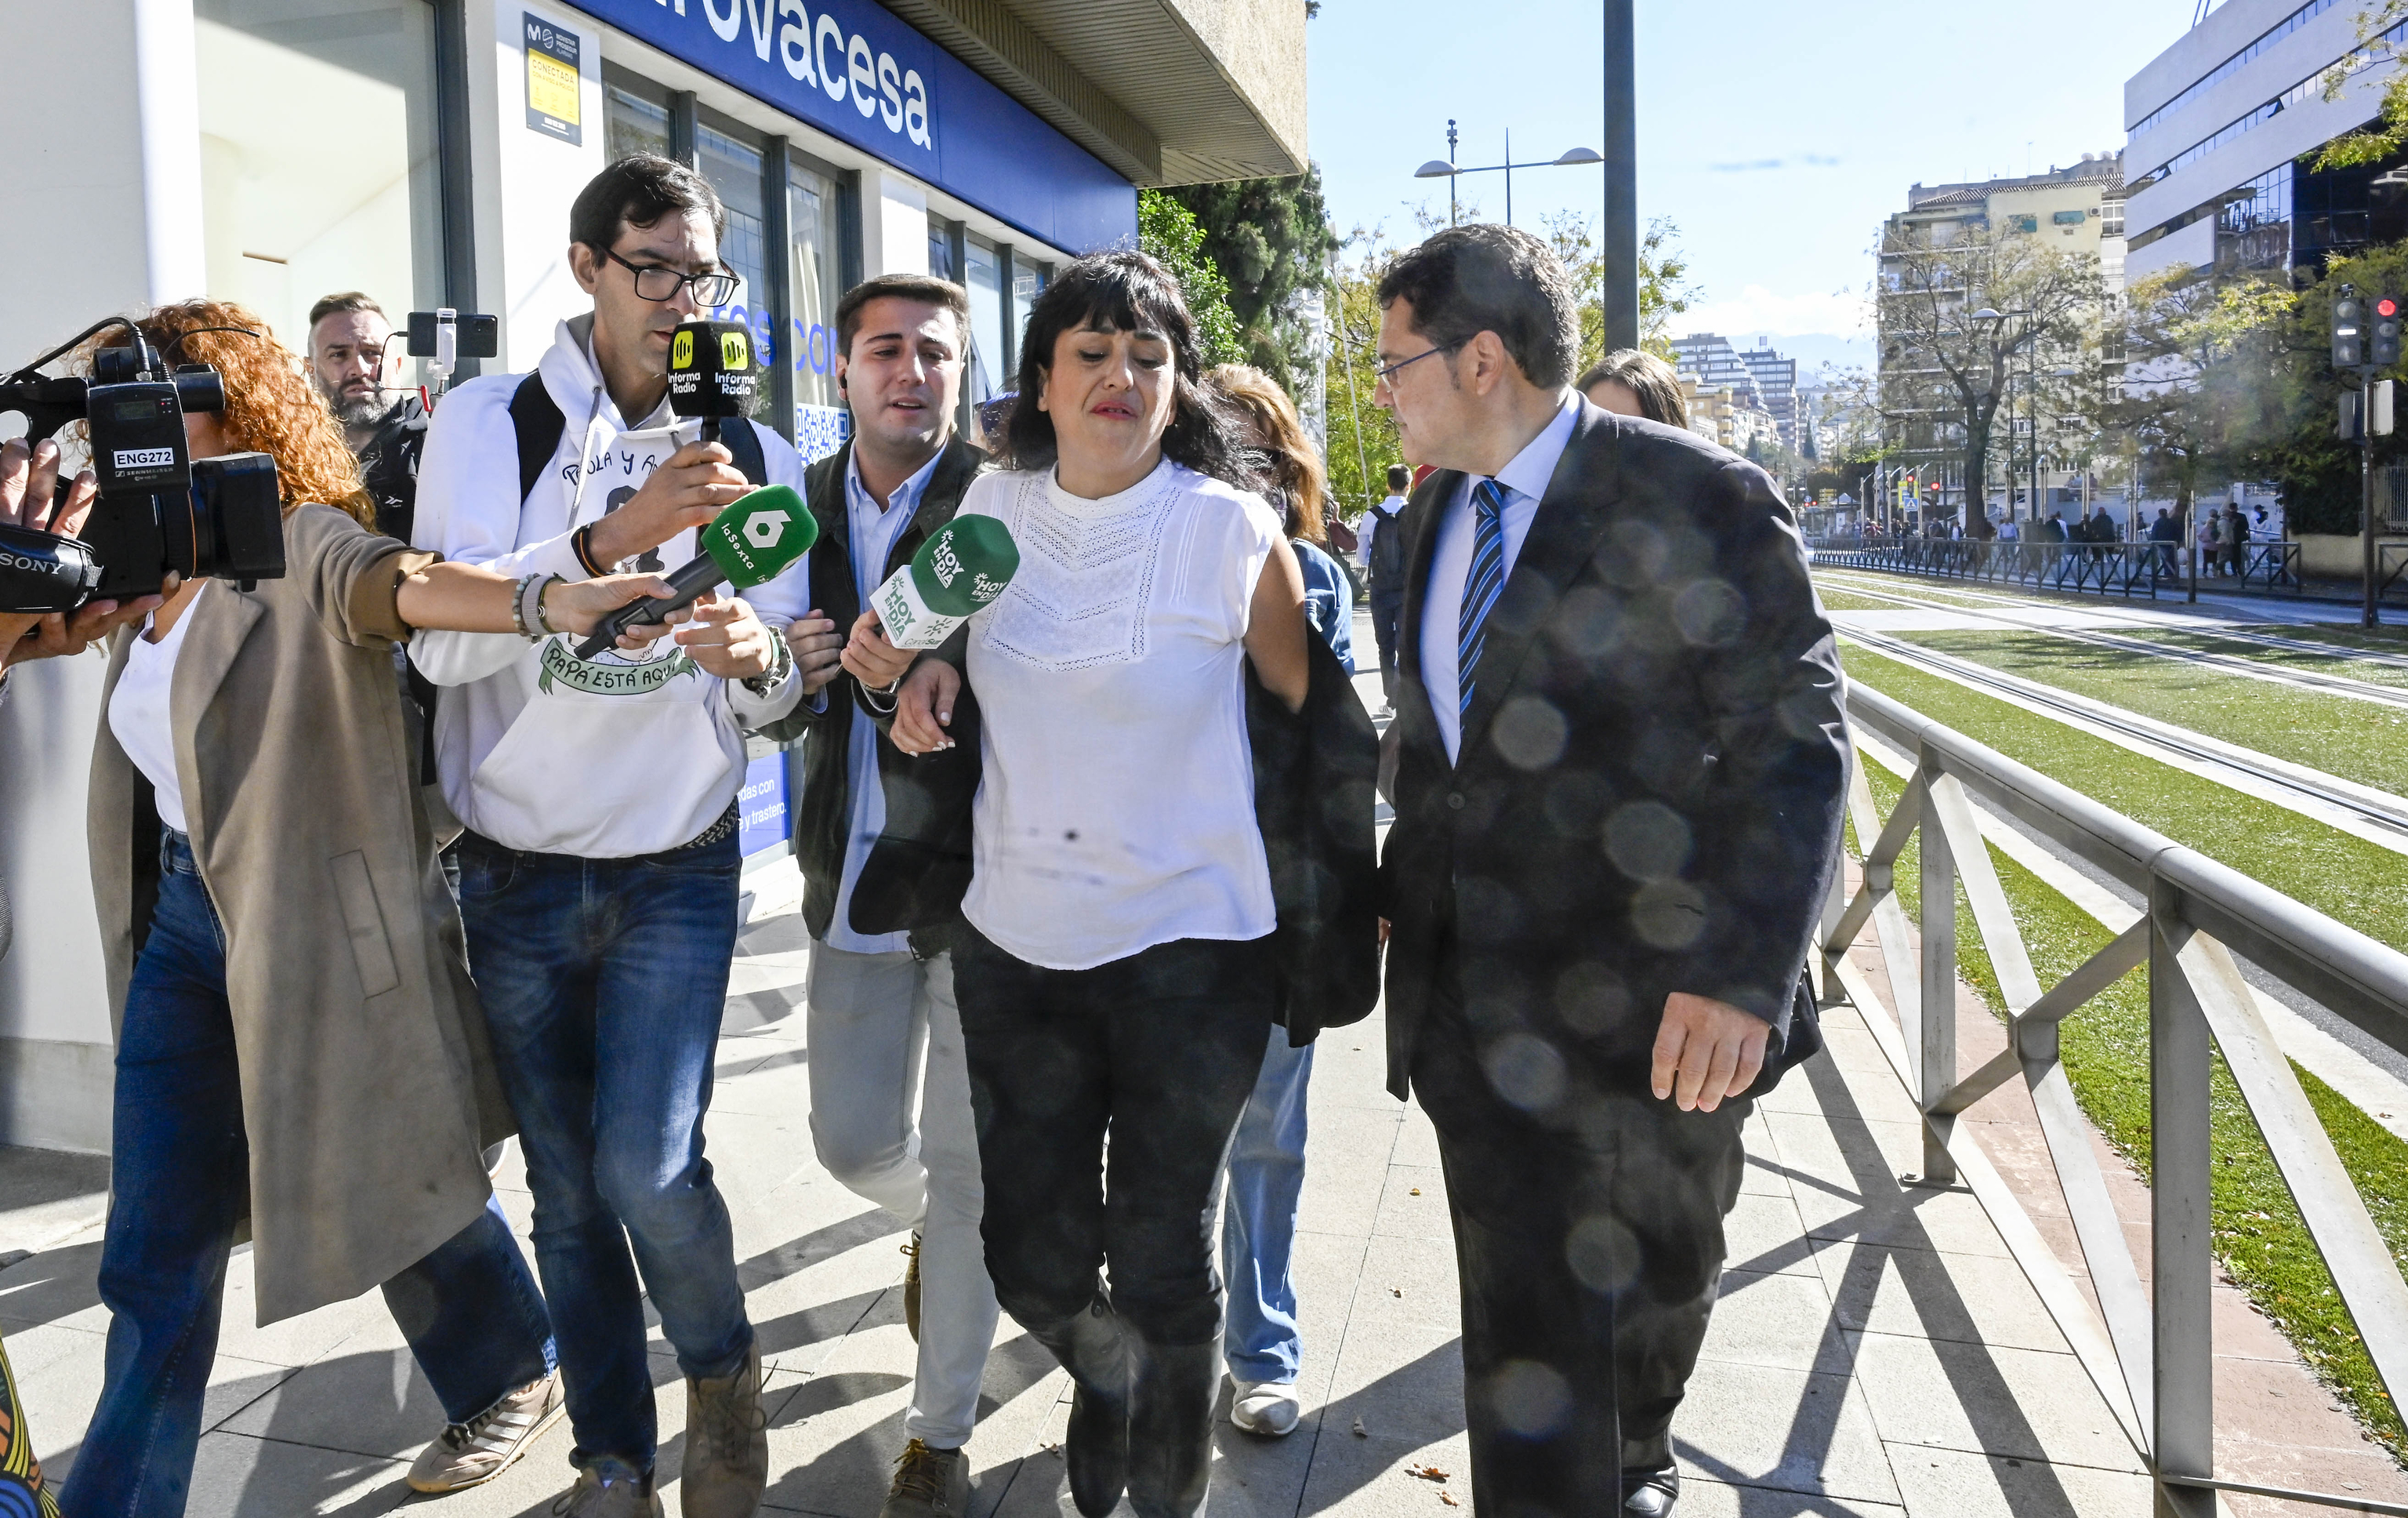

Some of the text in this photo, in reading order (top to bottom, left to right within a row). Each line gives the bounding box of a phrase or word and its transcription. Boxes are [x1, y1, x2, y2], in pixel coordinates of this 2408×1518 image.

[532, 59, 574, 84] CONECTADA
[655, 0, 932, 151] vacesa
[668, 372, 701, 384] Informa
[673, 382, 697, 394] Radio
[715, 372, 756, 385] Informa
[721, 383, 752, 395] Radio
[117, 451, 172, 465] ENG272
[721, 522, 755, 570] laSexta
[934, 548, 942, 561] EN
[0, 553, 64, 575] SONY
[938, 539, 965, 576] HOY
[936, 559, 954, 586] DÍA
[976, 580, 1007, 592] HOY
[884, 597, 894, 611] EN
[890, 586, 916, 626] HOY
[888, 609, 905, 638] DÍA
[546, 647, 680, 688] PAPÁ ESTÁ AQUÍ
[758, 779, 775, 795] con
[745, 815, 750, 832] y
[752, 801, 787, 825] trastero.
